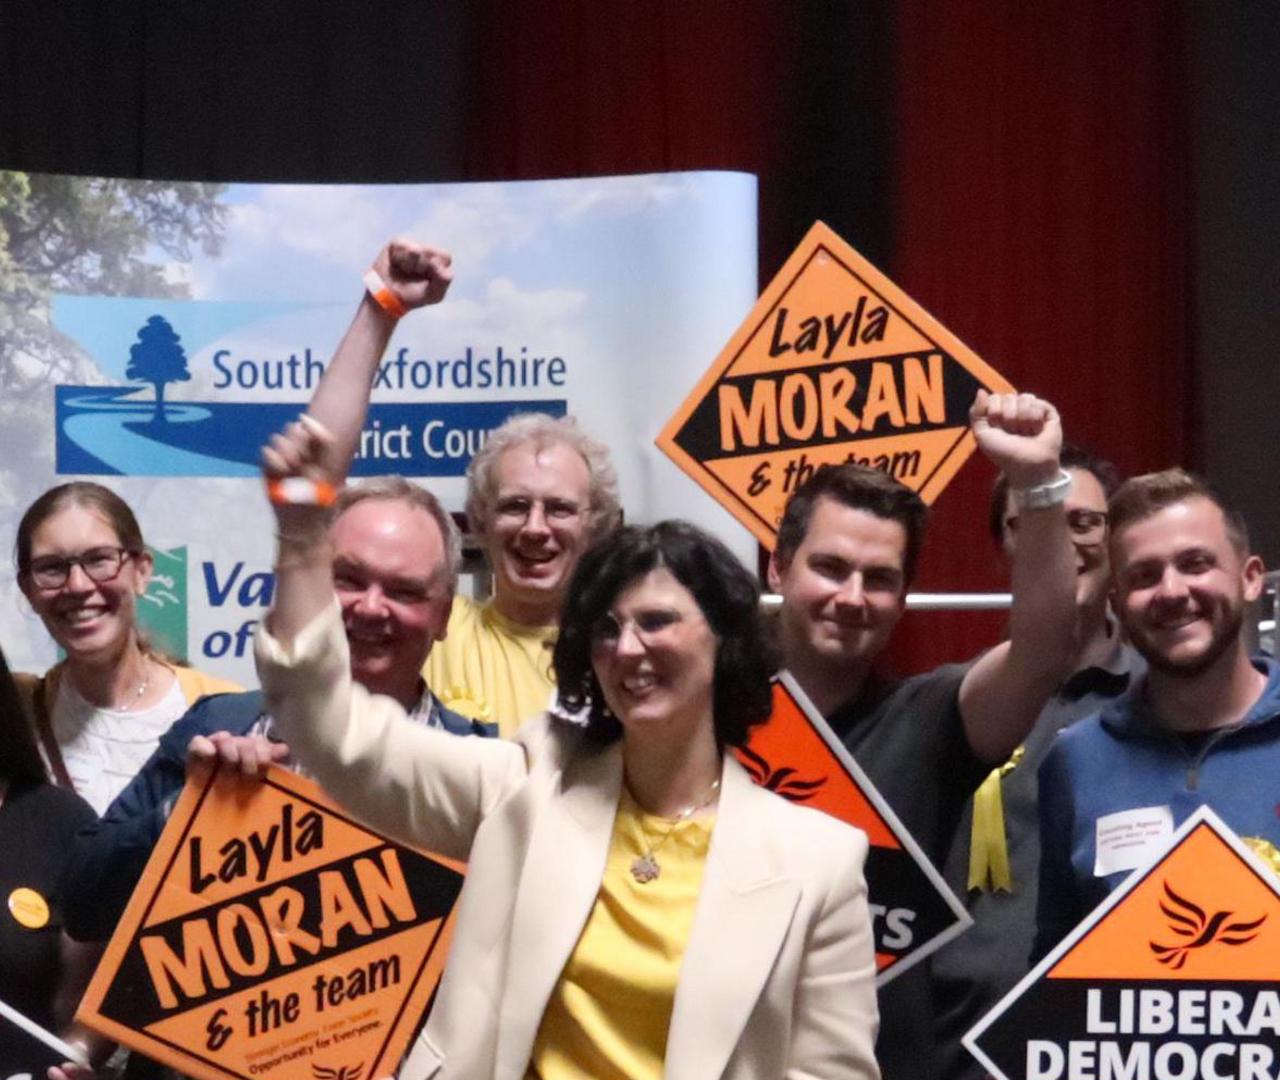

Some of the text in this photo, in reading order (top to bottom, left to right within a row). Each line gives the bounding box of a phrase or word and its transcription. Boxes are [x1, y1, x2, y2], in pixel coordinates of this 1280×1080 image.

[768, 296, 891, 360] Layla
[212, 347, 567, 389] South xfordshire
[719, 354, 946, 452] MORAN
[746, 460, 772, 497] &
[782, 453, 829, 493] th
[202, 561, 278, 608] Va
[202, 619, 260, 658] of
[189, 803, 324, 894] Layla
[140, 848, 418, 1011] MORAN
[205, 954, 401, 1052] & the team
[248, 1045, 314, 1075] Opportunity
[316, 1037, 331, 1049] for
